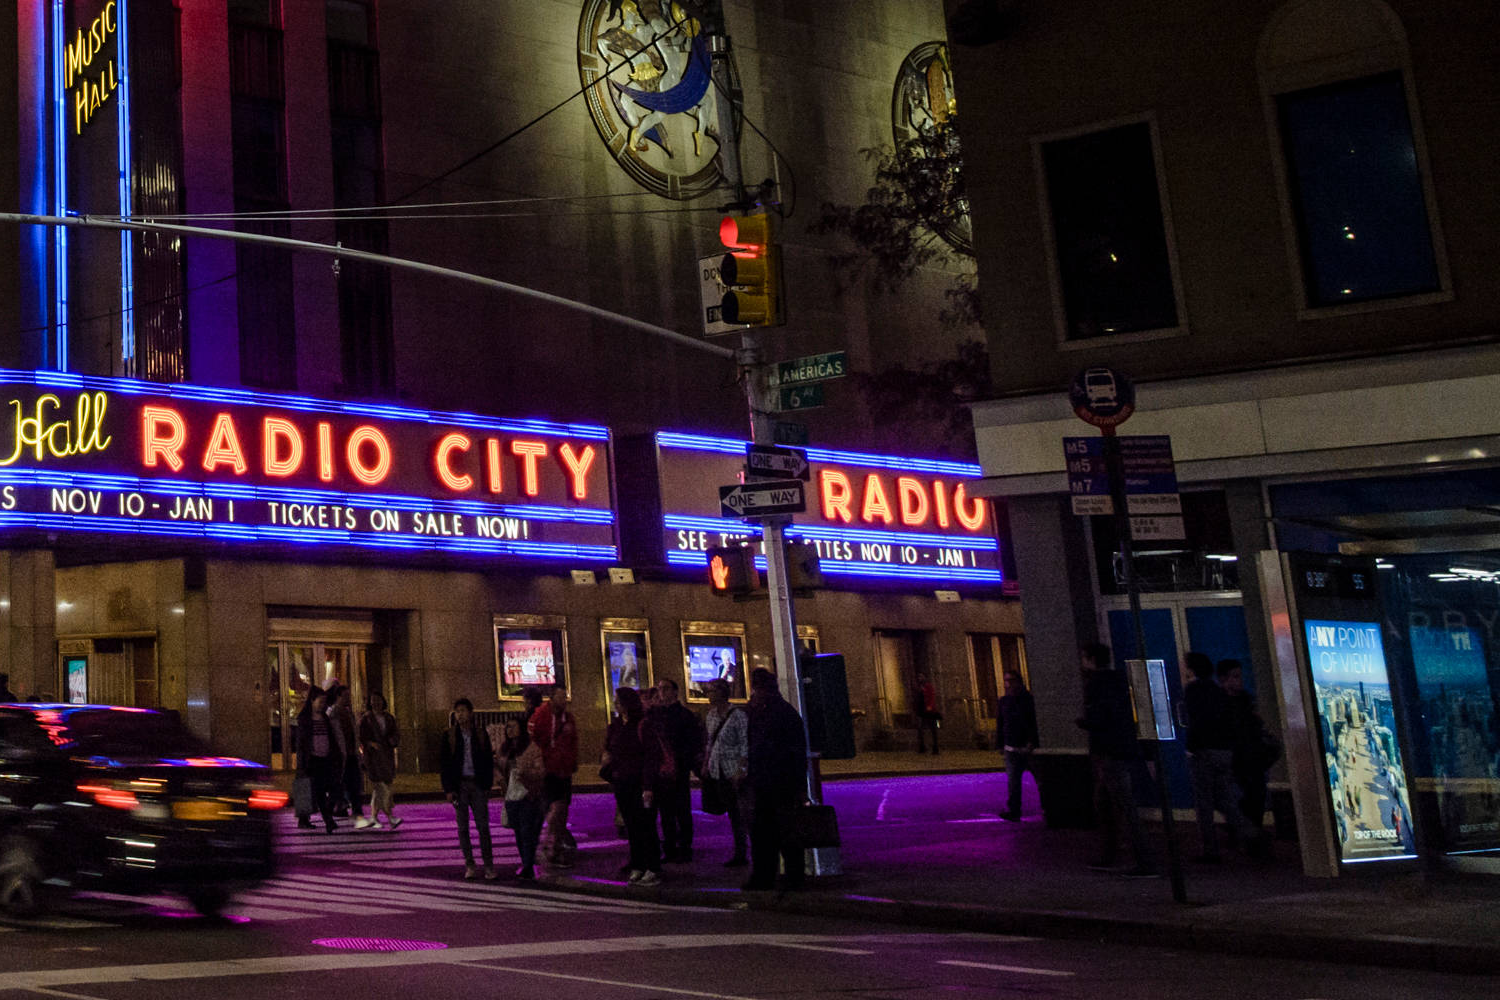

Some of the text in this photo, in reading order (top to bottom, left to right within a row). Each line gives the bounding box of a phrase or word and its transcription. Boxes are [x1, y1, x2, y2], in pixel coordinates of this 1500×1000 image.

[63, 0, 117, 89] MUSIC
[74, 60, 119, 135] HALL
[782, 360, 843, 383] AMERICAS
[789, 390, 802, 408] 6
[142, 405, 596, 500] RADIO CITY
[1066, 439, 1089, 454] M5
[752, 454, 802, 471] ONE WAY
[1069, 458, 1092, 473] M5
[1071, 478, 1093, 493] M7
[728, 489, 797, 508] ONE WAY
[819, 468, 986, 530] RADIO
[51, 488, 101, 513] NOV
[169, 496, 213, 521] JAN
[268, 502, 357, 530] TICKETS
[370, 509, 400, 532] ON
[413, 511, 464, 536] SALE
[476, 516, 529, 540] NOW!
[678, 529, 749, 551] SEE TE
[860, 542, 892, 563] NOV
[936, 547, 964, 567] JAN
[1310, 625, 1337, 649] ANY
[1337, 626, 1378, 650] POINT
[1320, 651, 1374, 674] OF VIEW
